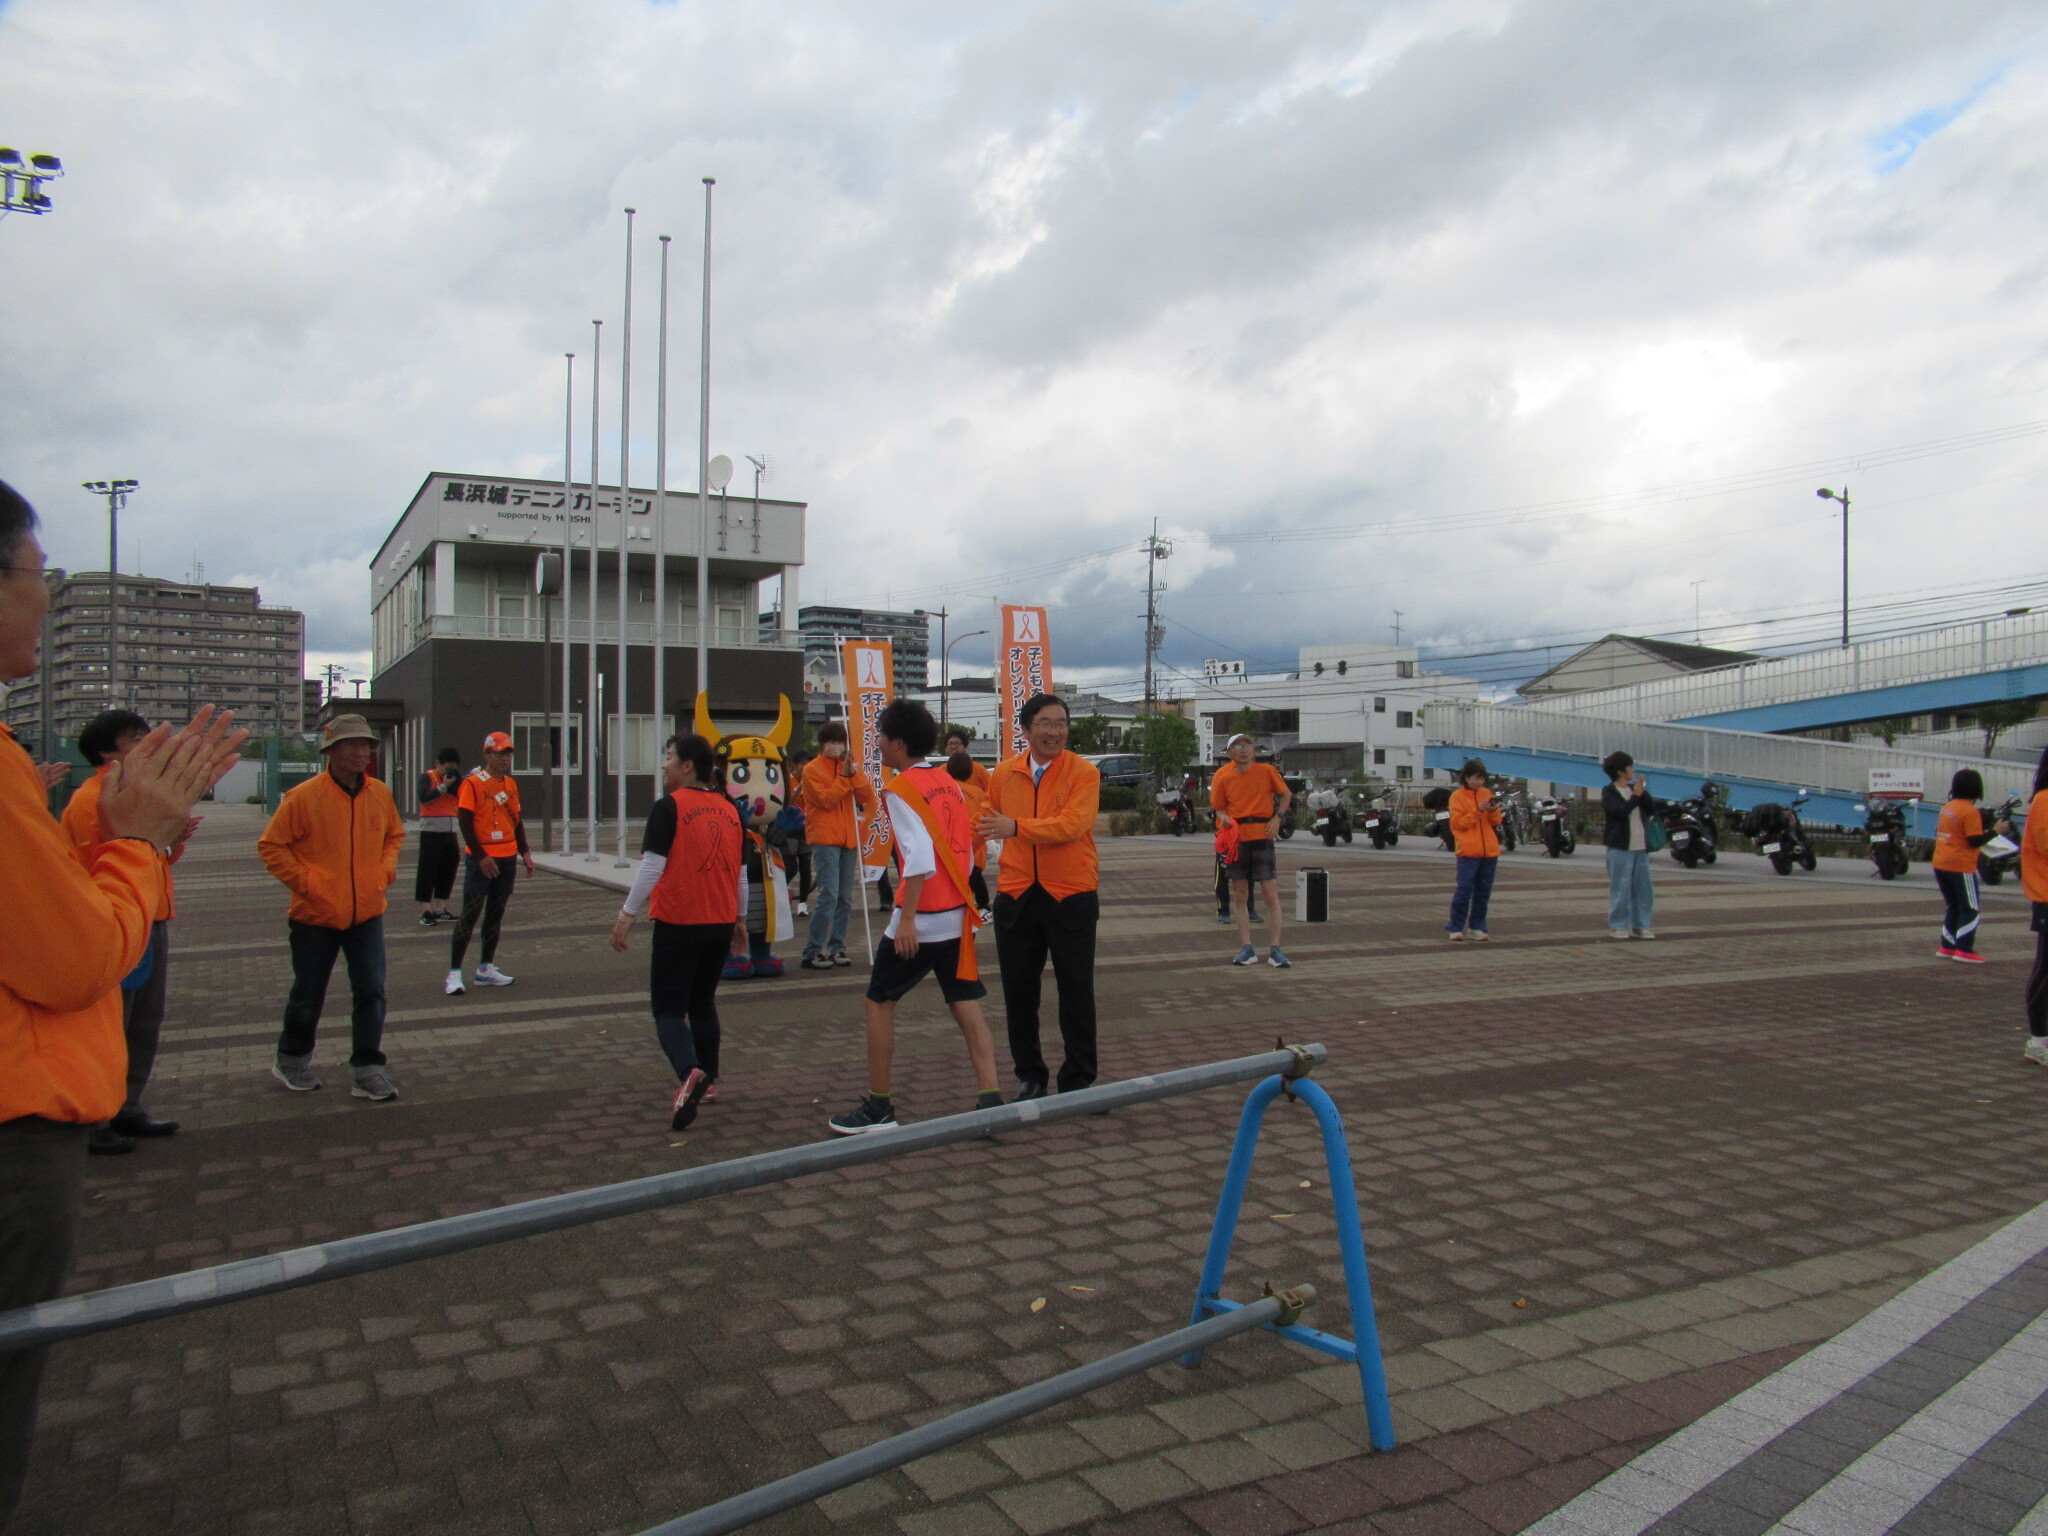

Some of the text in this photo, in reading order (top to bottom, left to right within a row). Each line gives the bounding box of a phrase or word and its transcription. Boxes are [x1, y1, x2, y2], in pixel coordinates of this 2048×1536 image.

[497, 511, 591, 524] supported by HISHI
[1010, 647, 1029, 755] オレンジリボンキ
[923, 786, 946, 805] hildren
[682, 807, 716, 826] Children
